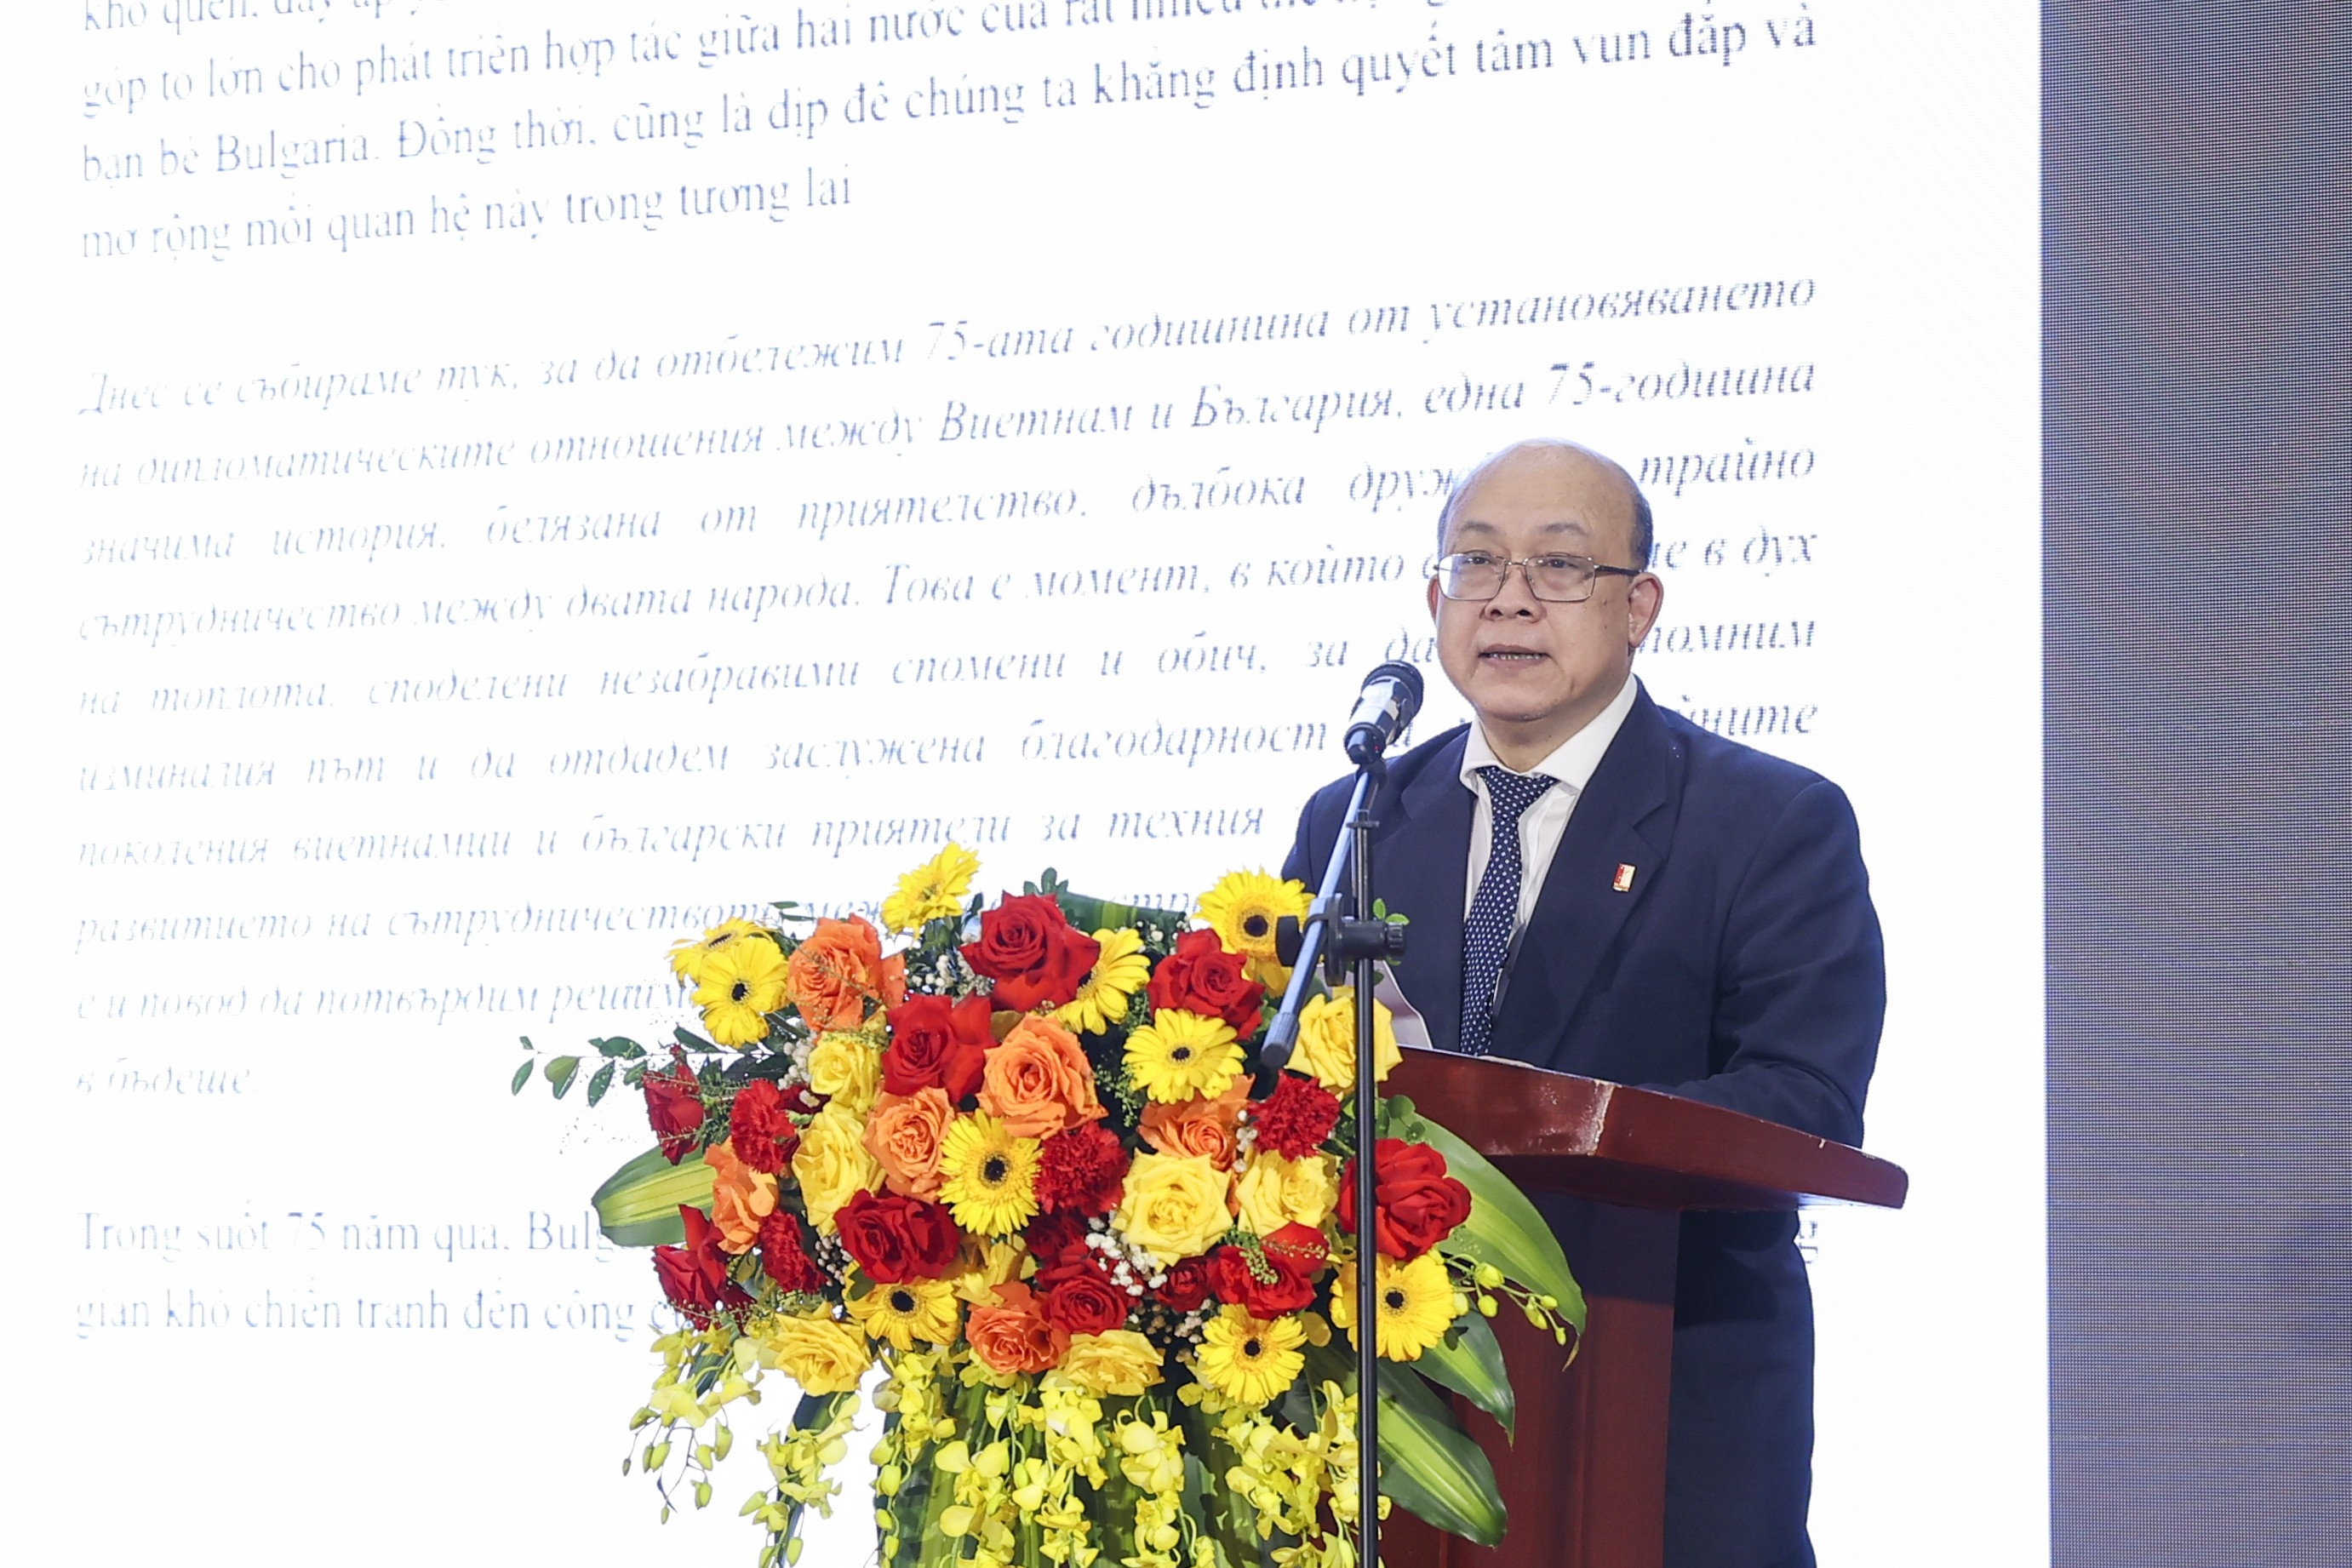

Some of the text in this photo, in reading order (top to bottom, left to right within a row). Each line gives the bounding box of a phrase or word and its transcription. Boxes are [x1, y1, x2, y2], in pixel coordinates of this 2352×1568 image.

[83, 66, 147, 120] góp
[161, 70, 194, 102] to
[208, 56, 264, 98] lớn
[277, 49, 341, 93] cho
[355, 40, 432, 98] phát
[545, 27, 616, 79] hợp
[629, 20, 683, 64] tác
[697, 12, 781, 70] giữa
[795, 2, 852, 50] hai
[83, 143, 144, 189] bạn
[159, 135, 200, 177] bè
[397, 102, 497, 166] Đồng
[612, 100, 705, 150] cũng
[722, 90, 753, 134] là
[767, 86, 829, 141] dịp
[904, 72, 1026, 125] chúng
[1042, 75, 1078, 109] ta
[1231, 43, 1325, 101] định
[1340, 19, 1457, 98] quyết
[1474, 27, 1554, 75] tâm
[1571, 29, 1652, 66] vun
[1763, 1, 1817, 50] và
[152, 212, 231, 263] rộng
[327, 209, 415, 254] quan
[430, 192, 471, 242] hệ
[484, 188, 549, 241] này
[564, 190, 664, 232] trong
[678, 180, 791, 224] tương
[806, 163, 851, 208] lai
[1742, 519, 1818, 578] дух
[83, 1211, 182, 1263] Trong
[342, 1213, 420, 1251] năm
[76, 1300, 151, 1341] gian
[165, 1288, 231, 1329] khó
[244, 1277, 341, 1330] chiến
[356, 1288, 449, 1330] tranh
[462, 1276, 530, 1331] đến
[543, 1288, 635, 1344] công
